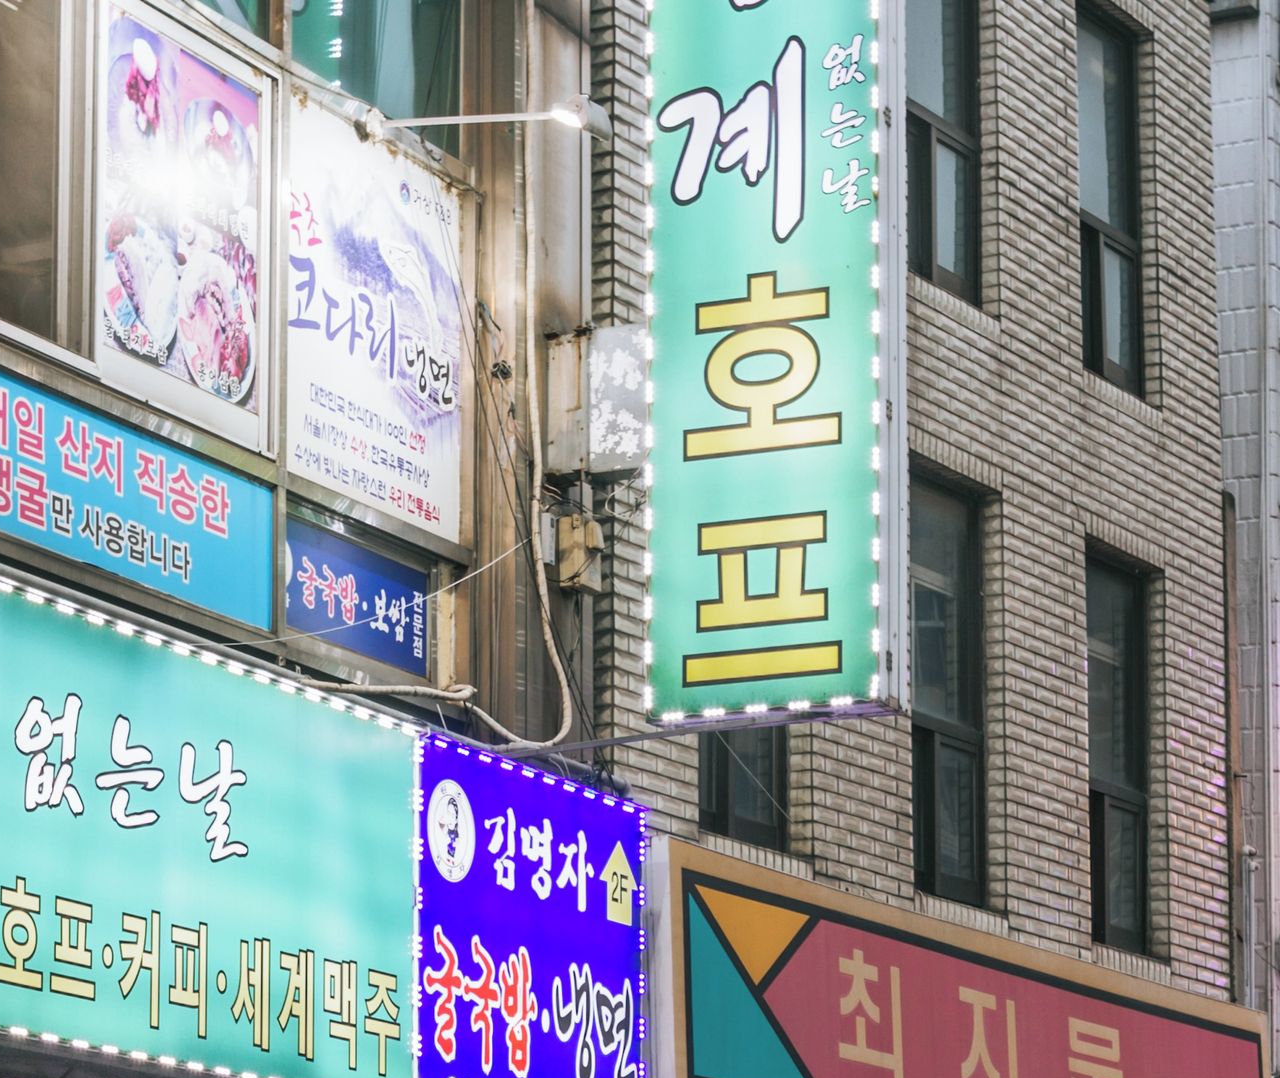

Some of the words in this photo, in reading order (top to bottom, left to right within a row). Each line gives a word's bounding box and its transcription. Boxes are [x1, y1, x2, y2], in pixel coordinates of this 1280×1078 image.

[657, 0, 806, 243] 계
[287, 254, 397, 380] 코다리
[405, 342, 453, 406] 냉면
[310, 382, 345, 417] 대한민국
[58, 417, 125, 497] 산지
[136, 448, 231, 539] 직송한
[323, 456, 350, 486] 빛나는
[352, 469, 387, 502] 자랑스런
[683, 270, 843, 688] 호프
[80, 508, 192, 584] 사용합니다
[413, 591, 424, 658] 전문점
[484, 808, 595, 913] 김명자
[610, 871, 629, 905] 2F
